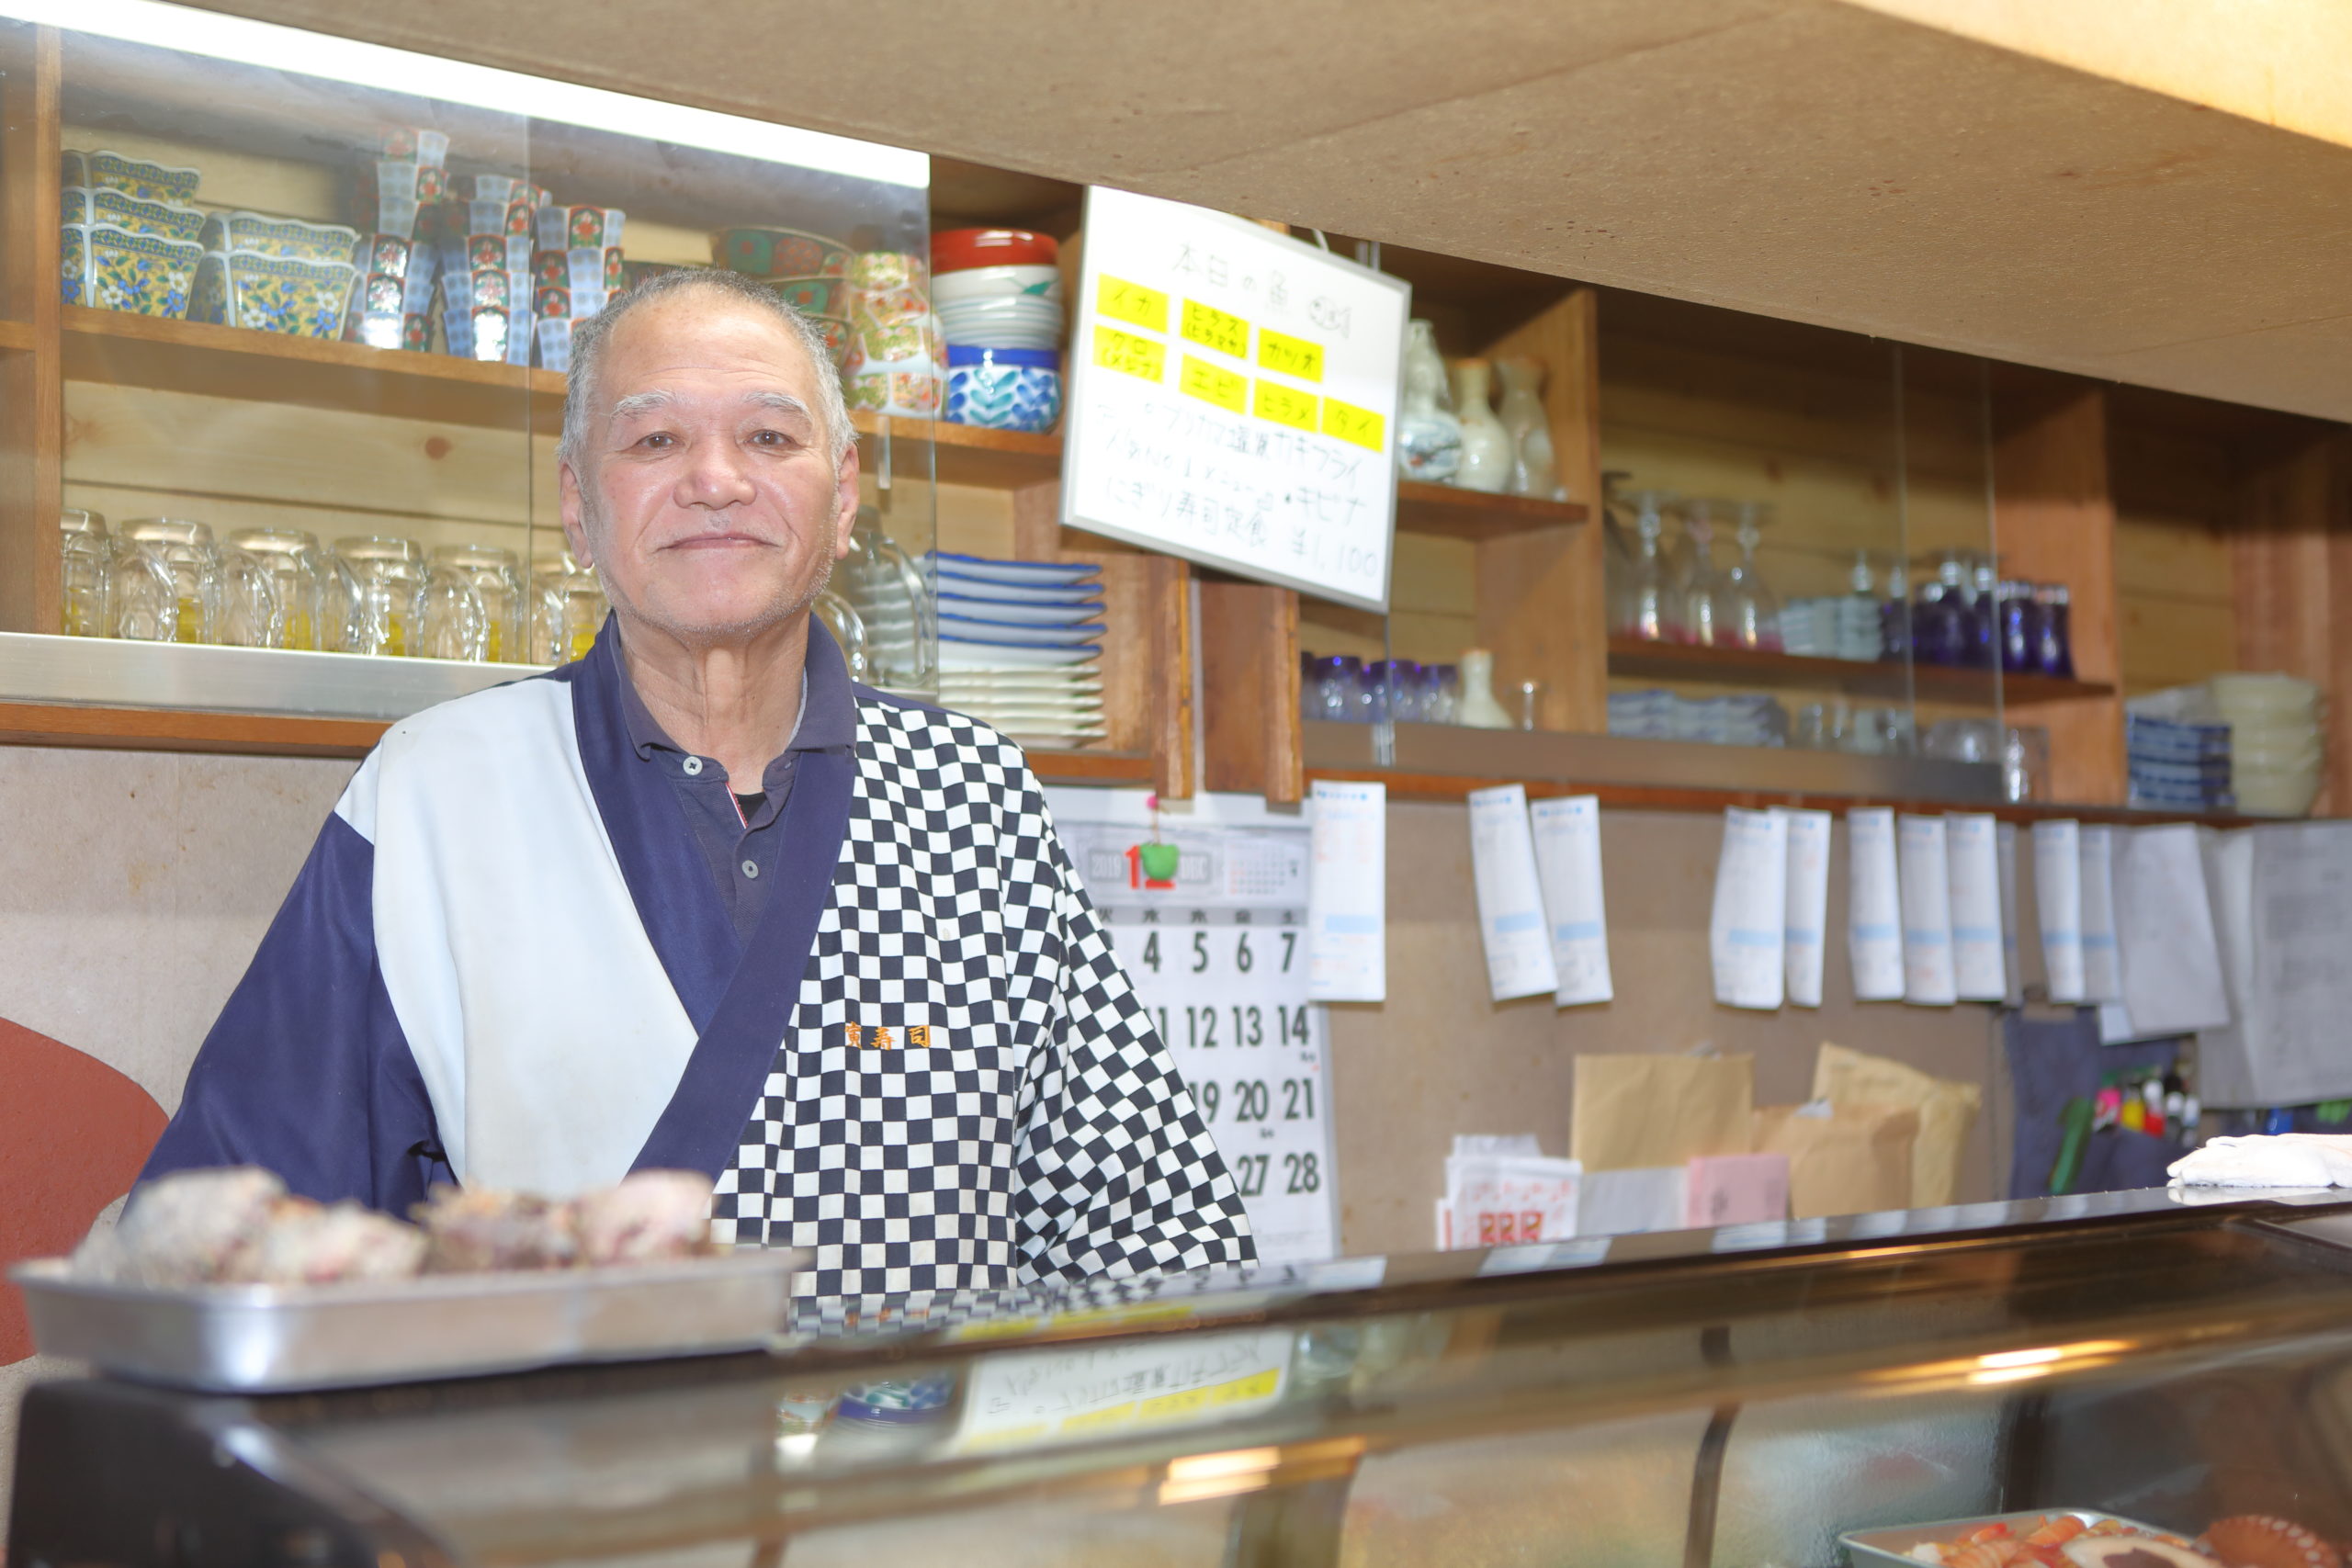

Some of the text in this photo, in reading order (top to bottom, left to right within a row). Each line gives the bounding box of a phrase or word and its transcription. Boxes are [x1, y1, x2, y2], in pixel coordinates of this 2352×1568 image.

[1143, 931, 1161, 974] 4
[1193, 931, 1209, 974] 5
[1237, 931, 1253, 974] 6
[1281, 931, 1297, 974] 7
[844, 1021, 931, 1051] 寅寿司
[1186, 1005, 1218, 1048] 12
[1232, 1005, 1264, 1047] 13
[1277, 1005, 1309, 1046] 14
[1235, 1079, 1270, 1122] 20
[1283, 1077, 1314, 1120] 21
[1237, 1152, 1320, 1197] 27 28
